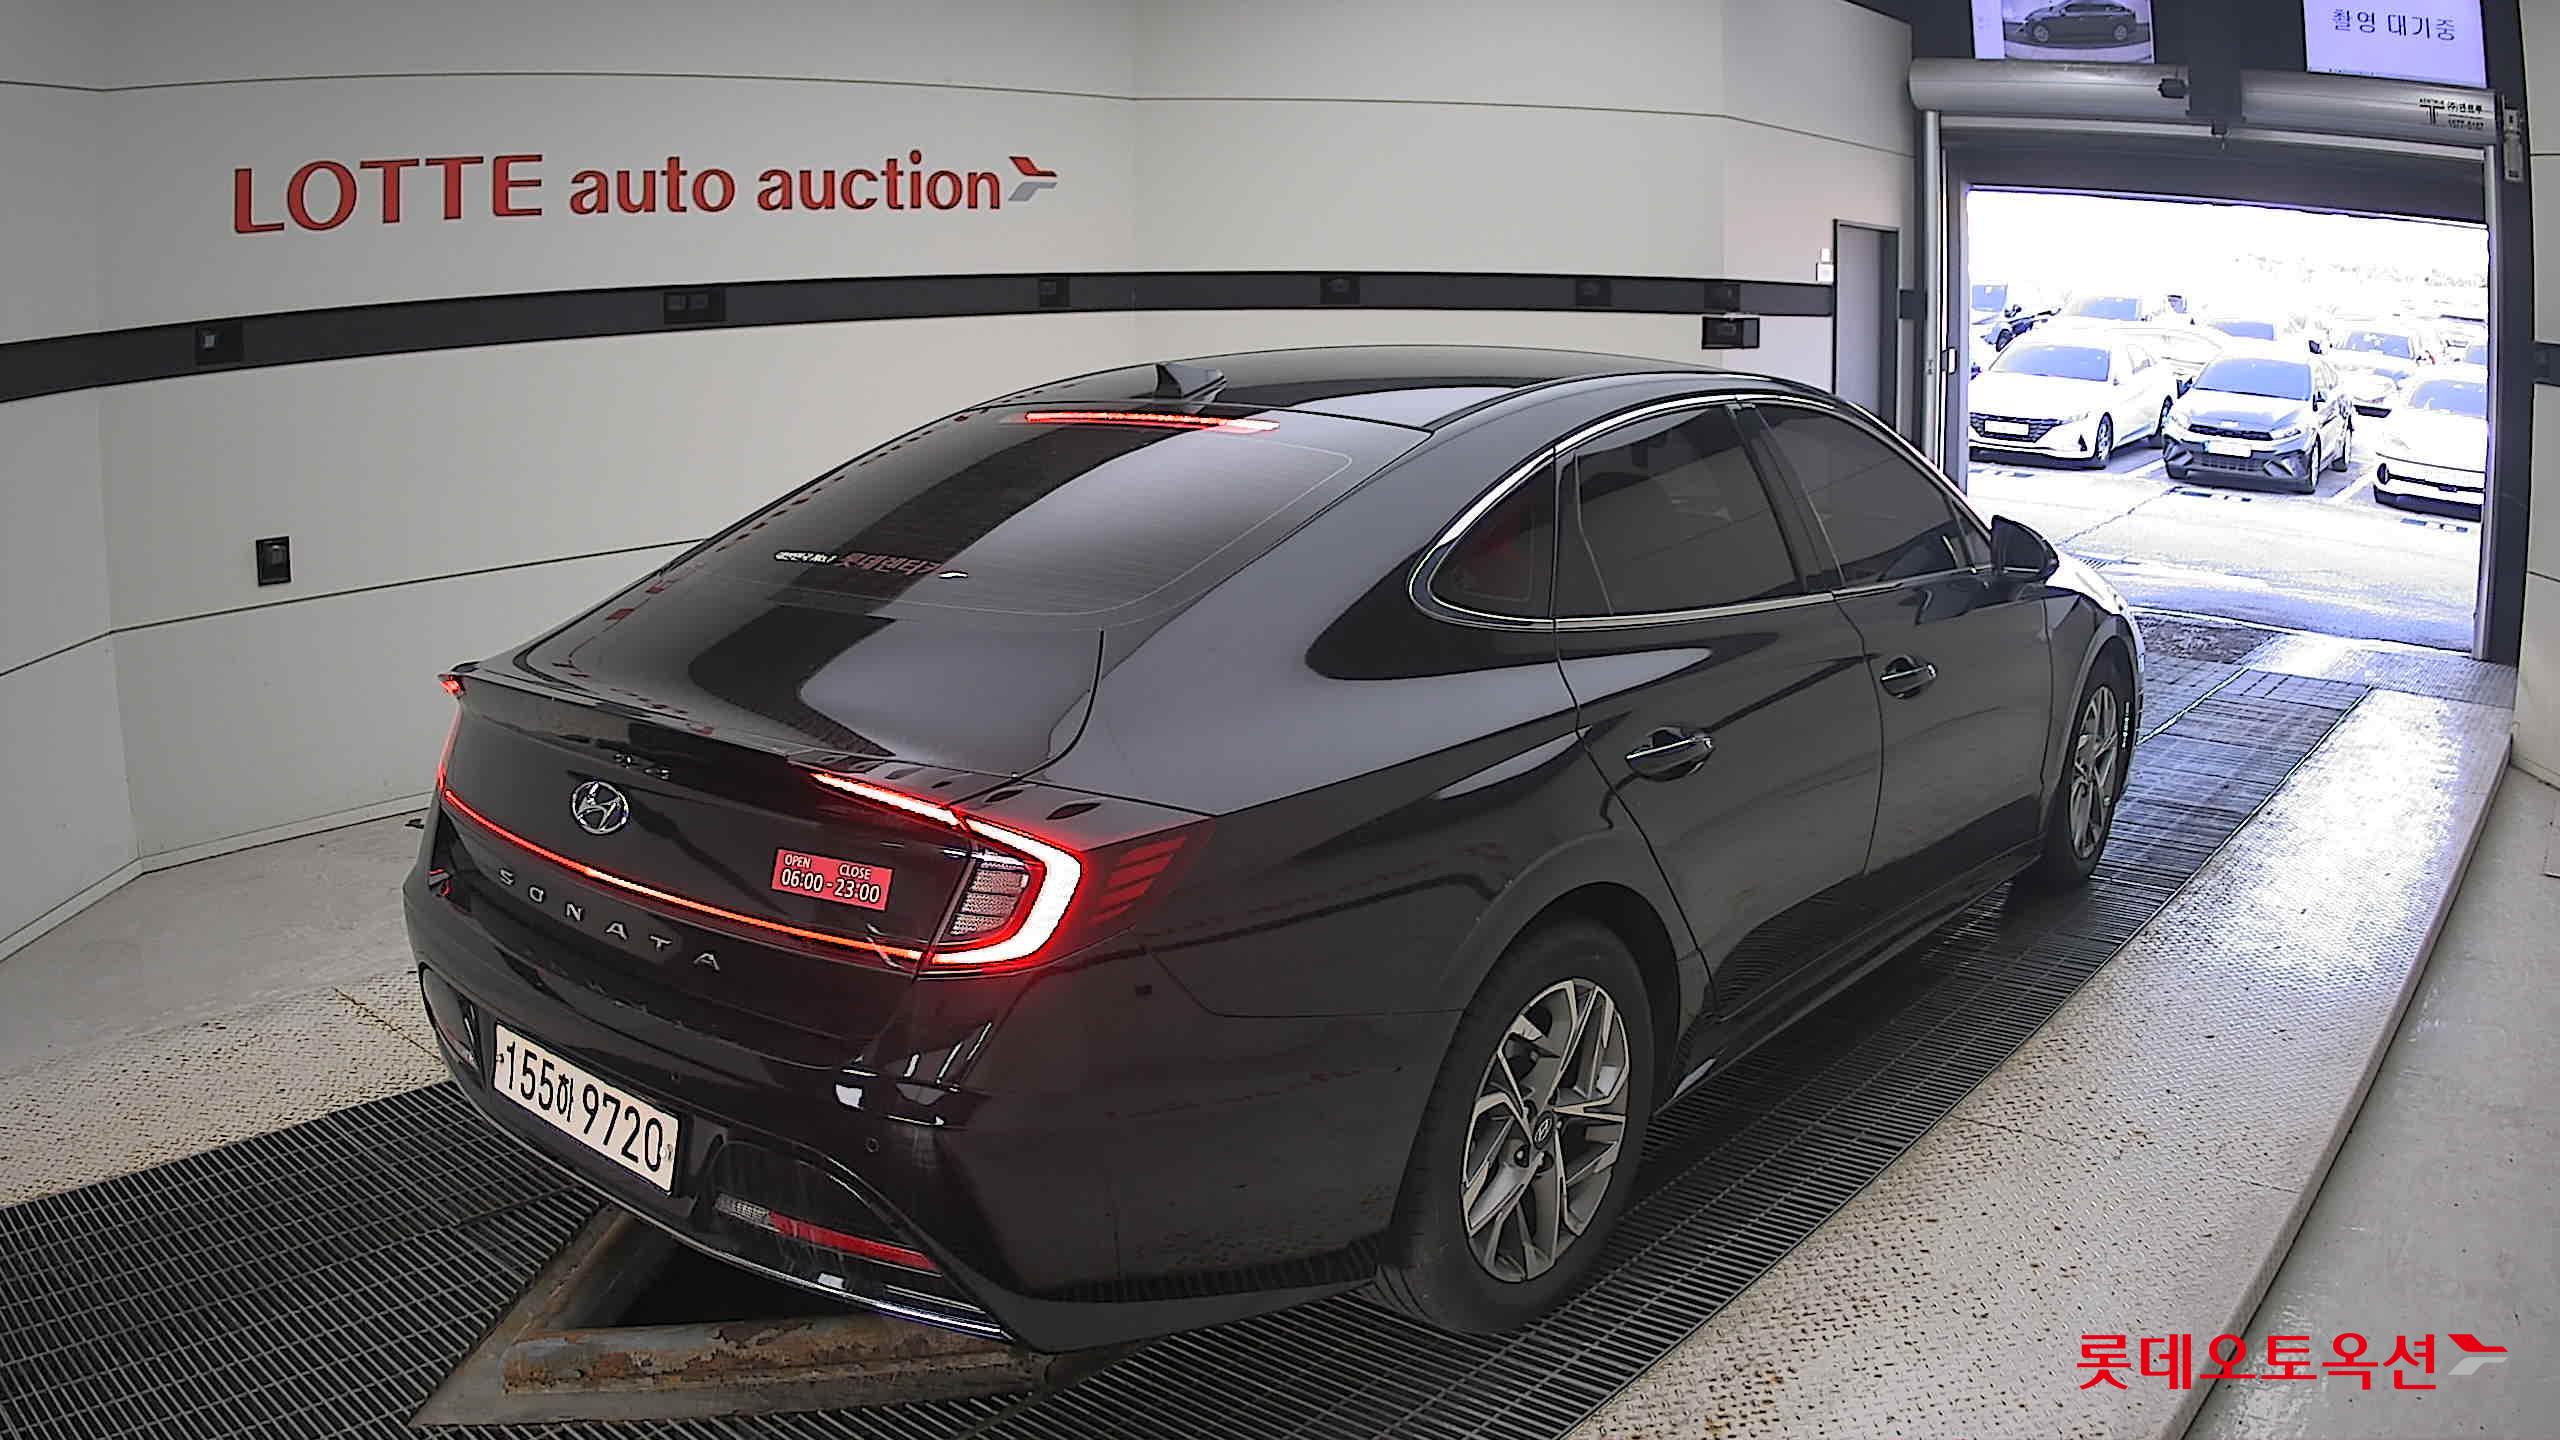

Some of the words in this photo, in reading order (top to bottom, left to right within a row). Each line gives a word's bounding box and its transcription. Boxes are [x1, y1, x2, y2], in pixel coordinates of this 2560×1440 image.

[234, 154, 543, 234] LOTTE
[569, 155, 736, 214] auto
[757, 149, 1001, 212] auction
[784, 854, 811, 868] OPEN
[839, 864, 872, 880] CLOSE
[499, 868, 720, 971] SONATA
